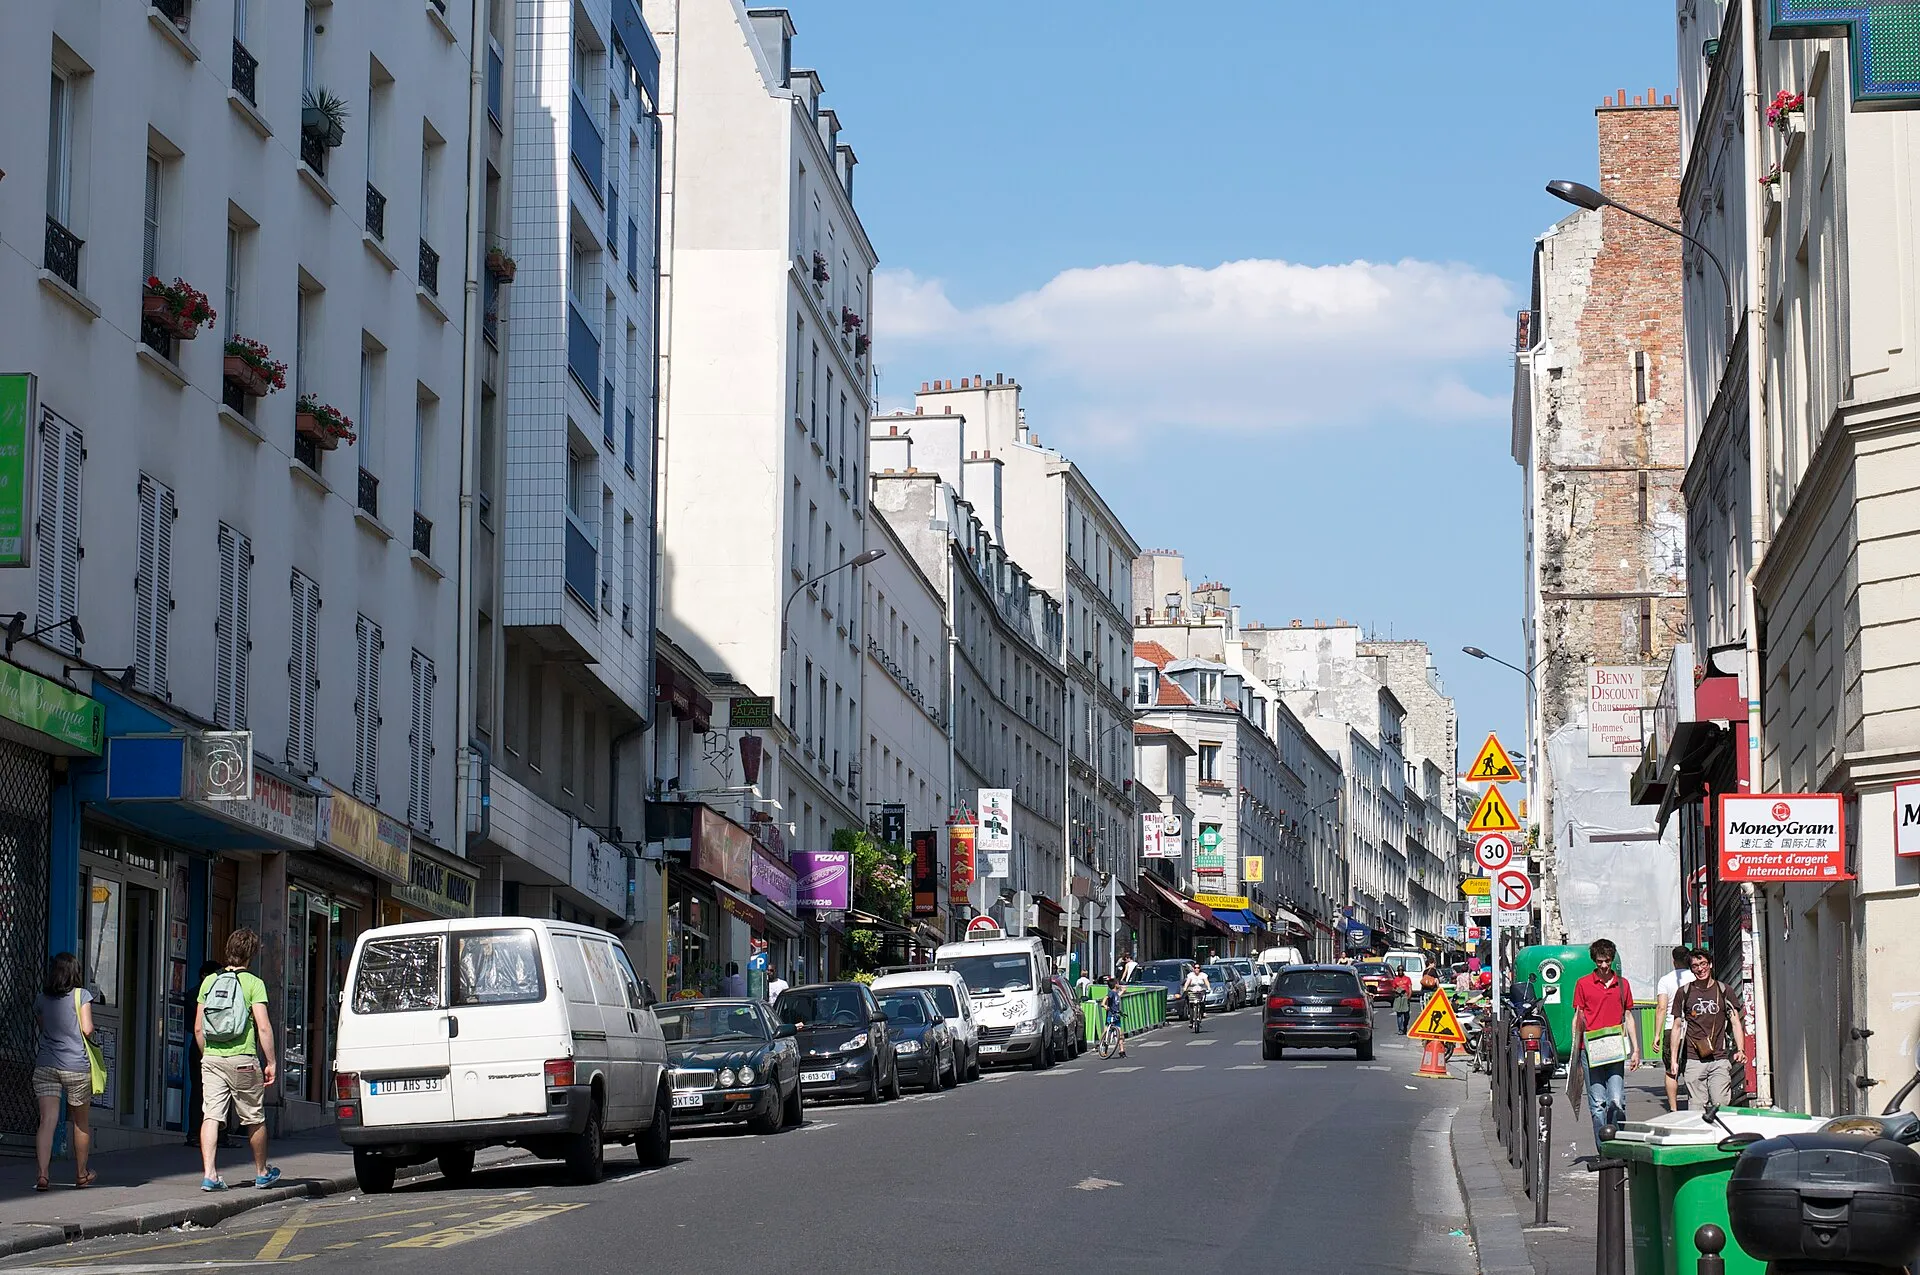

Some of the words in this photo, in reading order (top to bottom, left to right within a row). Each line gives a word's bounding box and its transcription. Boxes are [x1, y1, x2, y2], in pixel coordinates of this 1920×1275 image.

[1596, 670, 1635, 684] BENNY
[1591, 685, 1640, 700] DISCOUNT
[731, 707, 772, 716] FALAFEL
[1622, 713, 1640, 724] Cuir
[1592, 723, 1624, 733] Hommes
[1601, 733, 1631, 743] Femmes
[1612, 743, 1639, 753] Enfants
[1728, 821, 1834, 838] MoneyGram
[1740, 838, 1774, 849] 速汇金
[1780, 838, 1827, 849] 国际汇款
[1484, 844, 1505, 859] 30
[814, 854, 845, 862] PIZZAS
[1735, 854, 1782, 864] Transfert
[1785, 853, 1829, 866] d'argent
[1746, 866, 1817, 876] international
[756, 957, 765, 969] P
[381, 1080, 398, 1093] 101
[403, 1078, 421, 1091] AHS
[425, 1077, 438, 1090] 93
[689, 1095, 700, 1105] 92
